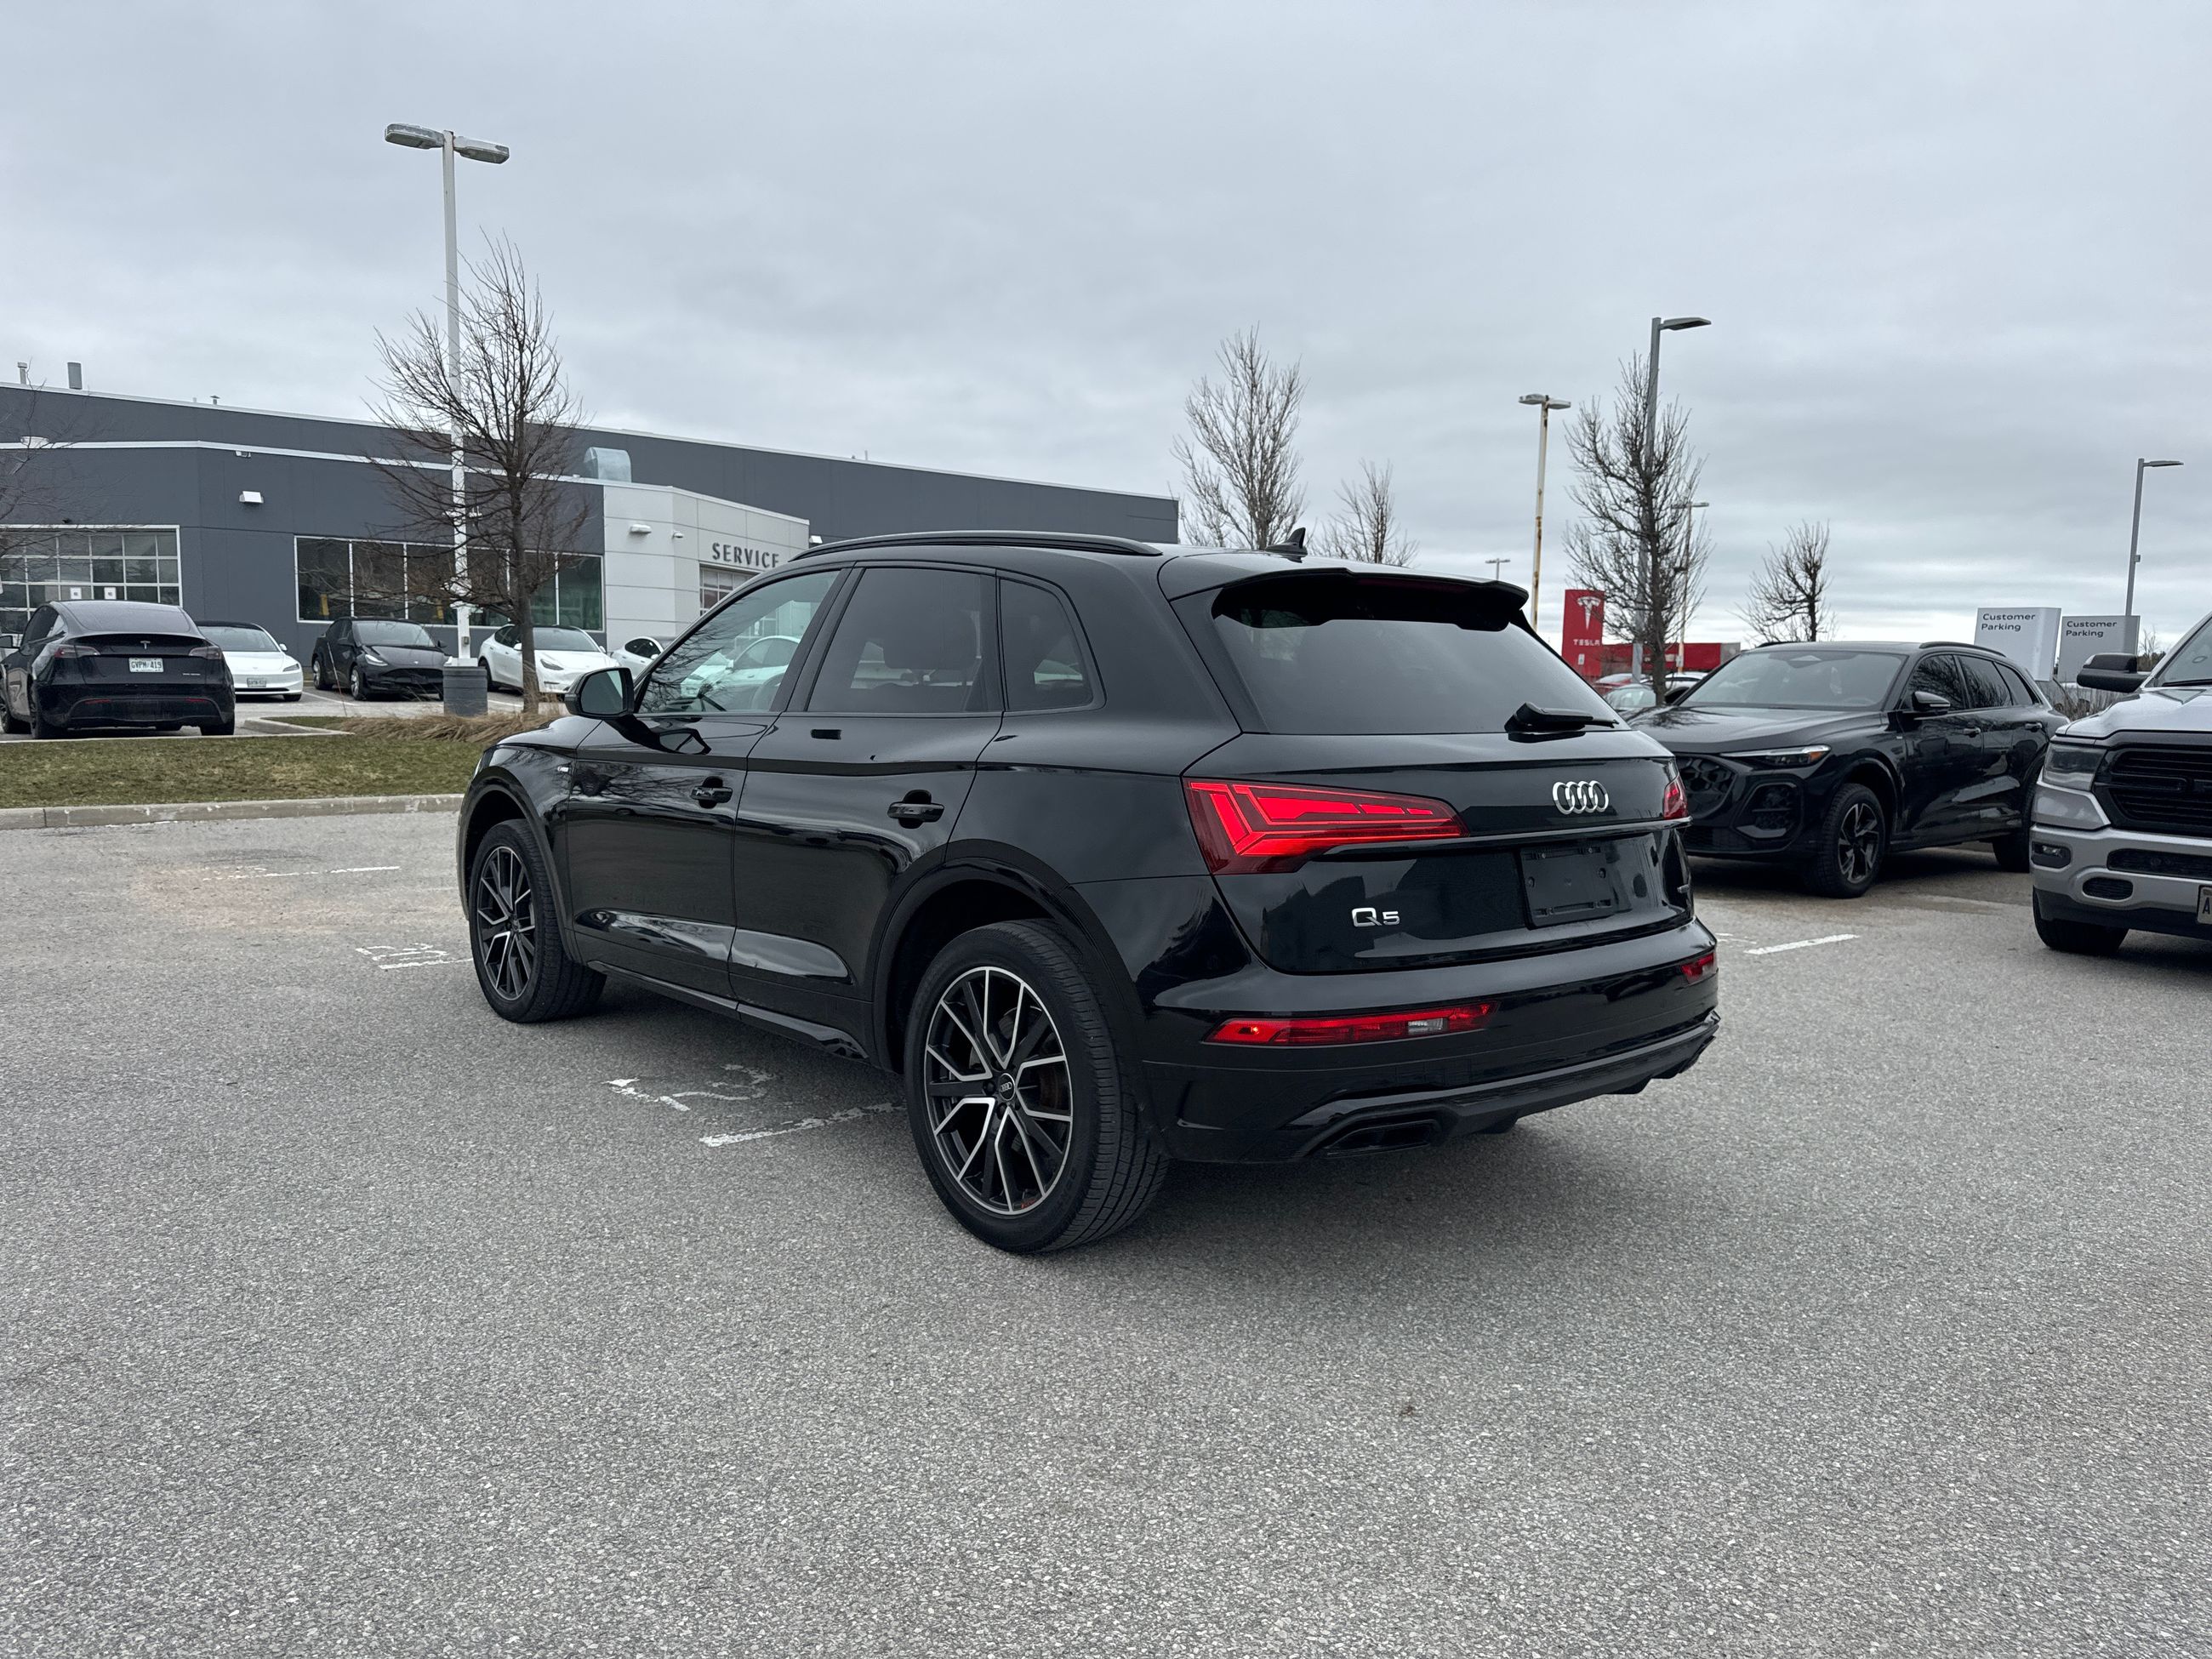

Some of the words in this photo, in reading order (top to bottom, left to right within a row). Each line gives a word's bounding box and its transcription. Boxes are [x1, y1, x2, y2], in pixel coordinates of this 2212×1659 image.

[712, 542, 779, 568] SERVICE
[1981, 623, 2021, 632] Parking
[2066, 630, 2104, 638] Parking
[1573, 638, 1600, 647] TESLA
[1351, 907, 1400, 927] Q5
